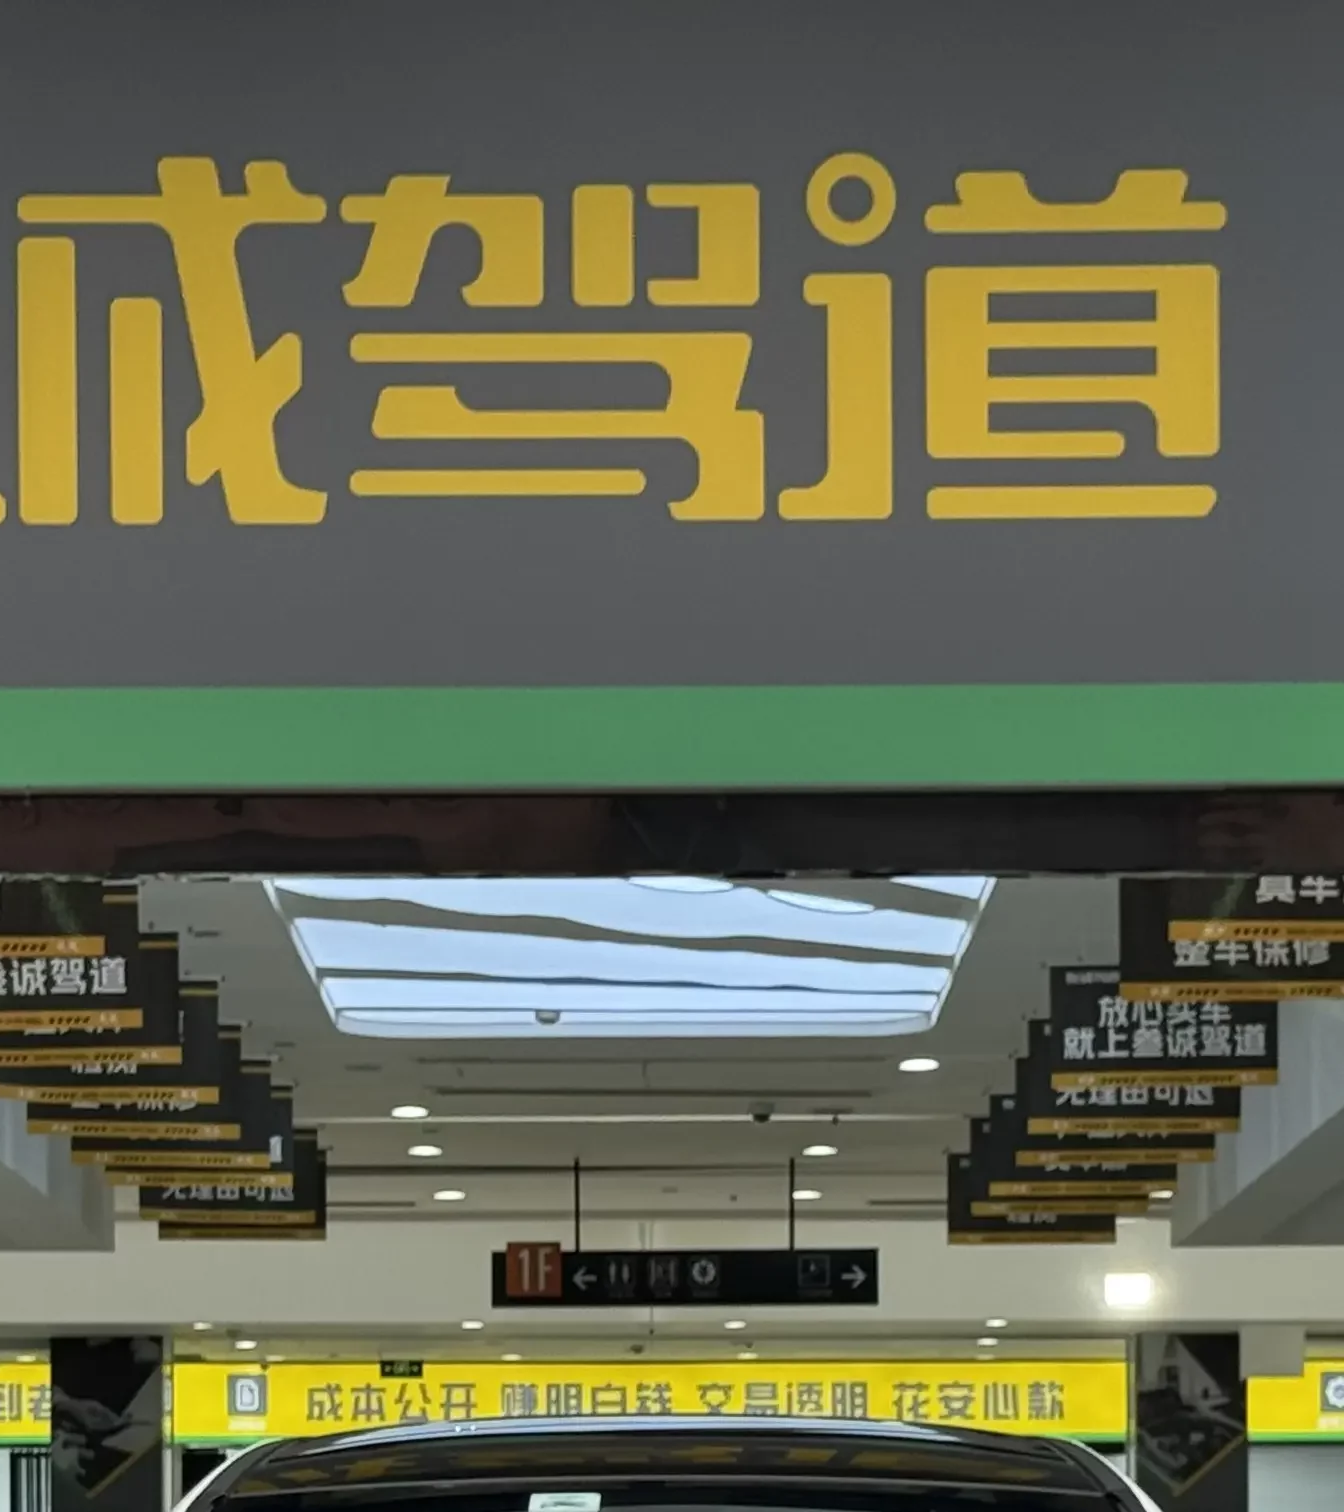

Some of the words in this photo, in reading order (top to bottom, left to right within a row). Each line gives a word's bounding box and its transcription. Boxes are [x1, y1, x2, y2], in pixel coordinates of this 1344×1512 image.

[518, 1247, 553, 1293] 1F
[306, 1382, 477, 1421] 成本公开
[697, 1380, 867, 1418] 交易透明
